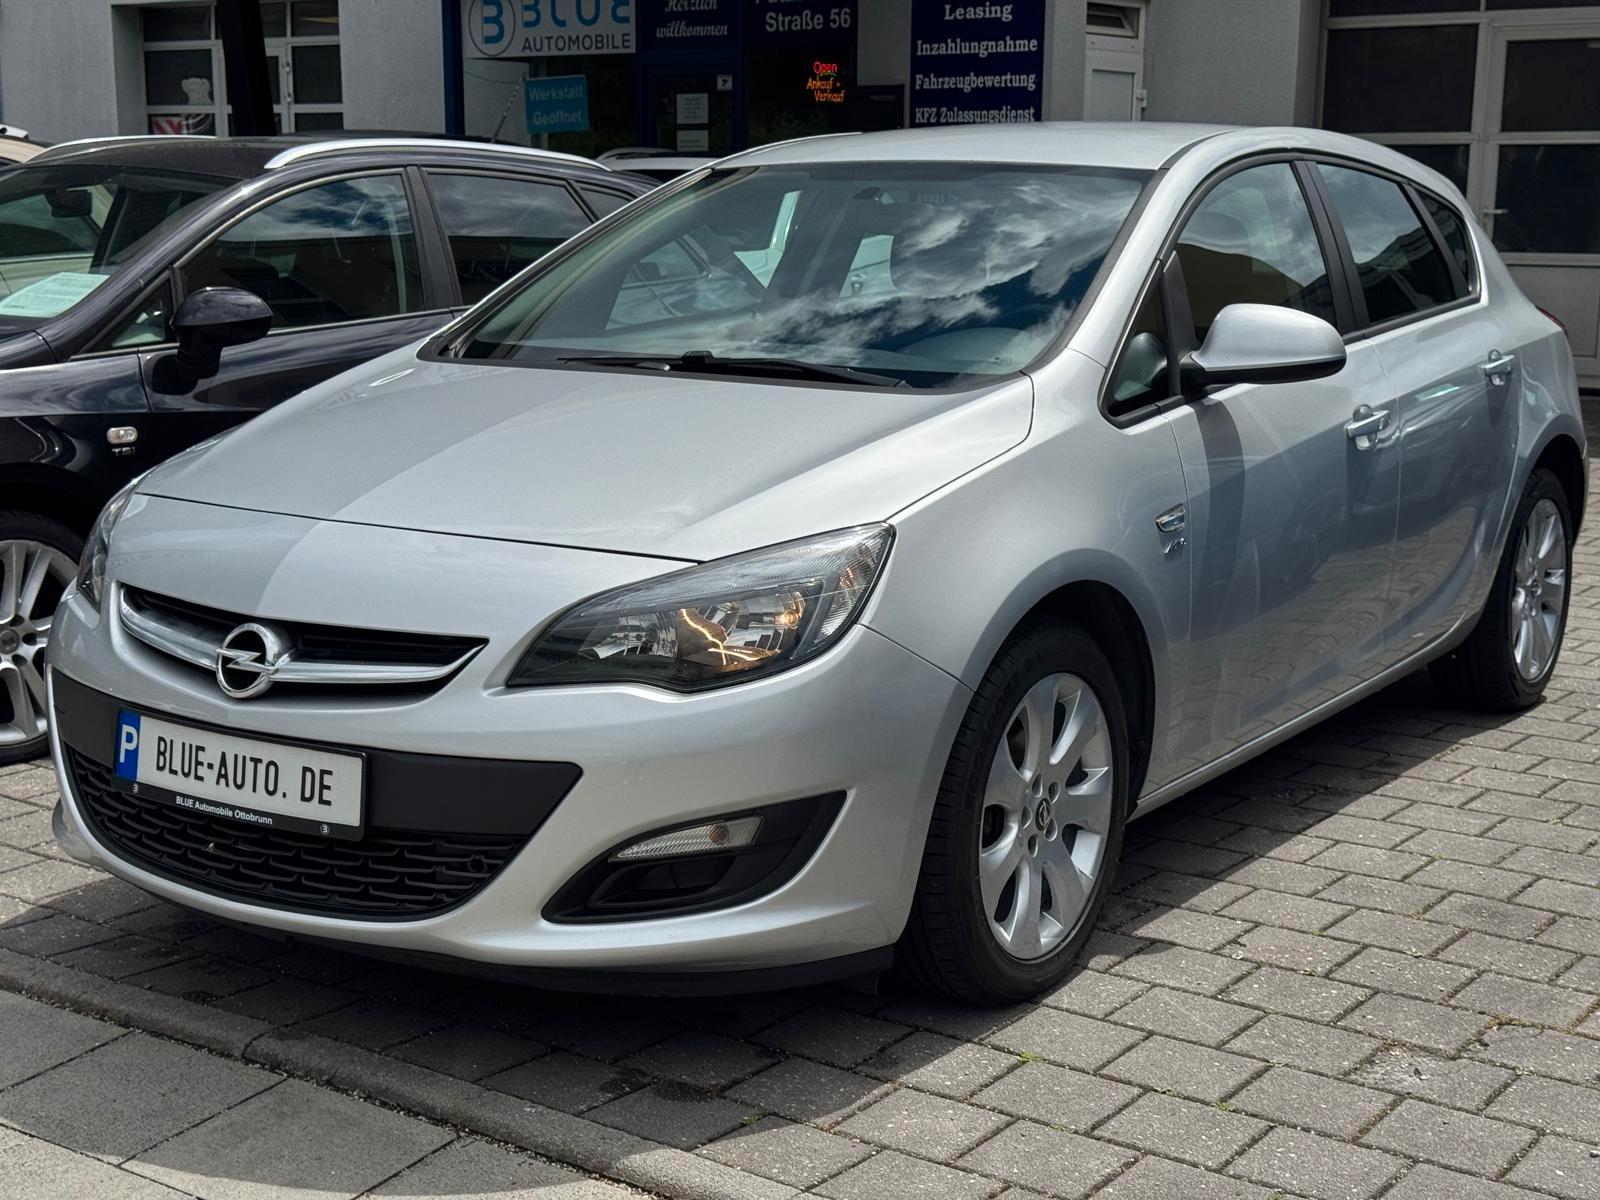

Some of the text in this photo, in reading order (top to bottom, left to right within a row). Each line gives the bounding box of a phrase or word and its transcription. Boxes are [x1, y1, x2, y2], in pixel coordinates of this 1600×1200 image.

[522, 0, 631, 28] BLUE
[764, 7, 852, 32] Straße 56
[943, 1, 1014, 22] Leasing
[656, 20, 729, 38] willkommen
[522, 33, 632, 53] AUTOMOBILE
[916, 36, 1039, 58] Inzahlungnahme
[813, 60, 839, 75] Open
[806, 77, 834, 90] Ankauf
[914, 71, 1037, 93] Fahrzeugbewertung
[528, 85, 584, 101] Werkstatt
[813, 90, 846, 103] Verkauf
[532, 110, 583, 127] Geöffnet
[914, 105, 1036, 124] KFZ Zulassungsdienst
[120, 724, 138, 764] P
[300, 766, 334, 806] DE
[175, 795, 273, 825] BLUE Automobile Ottobrunn
